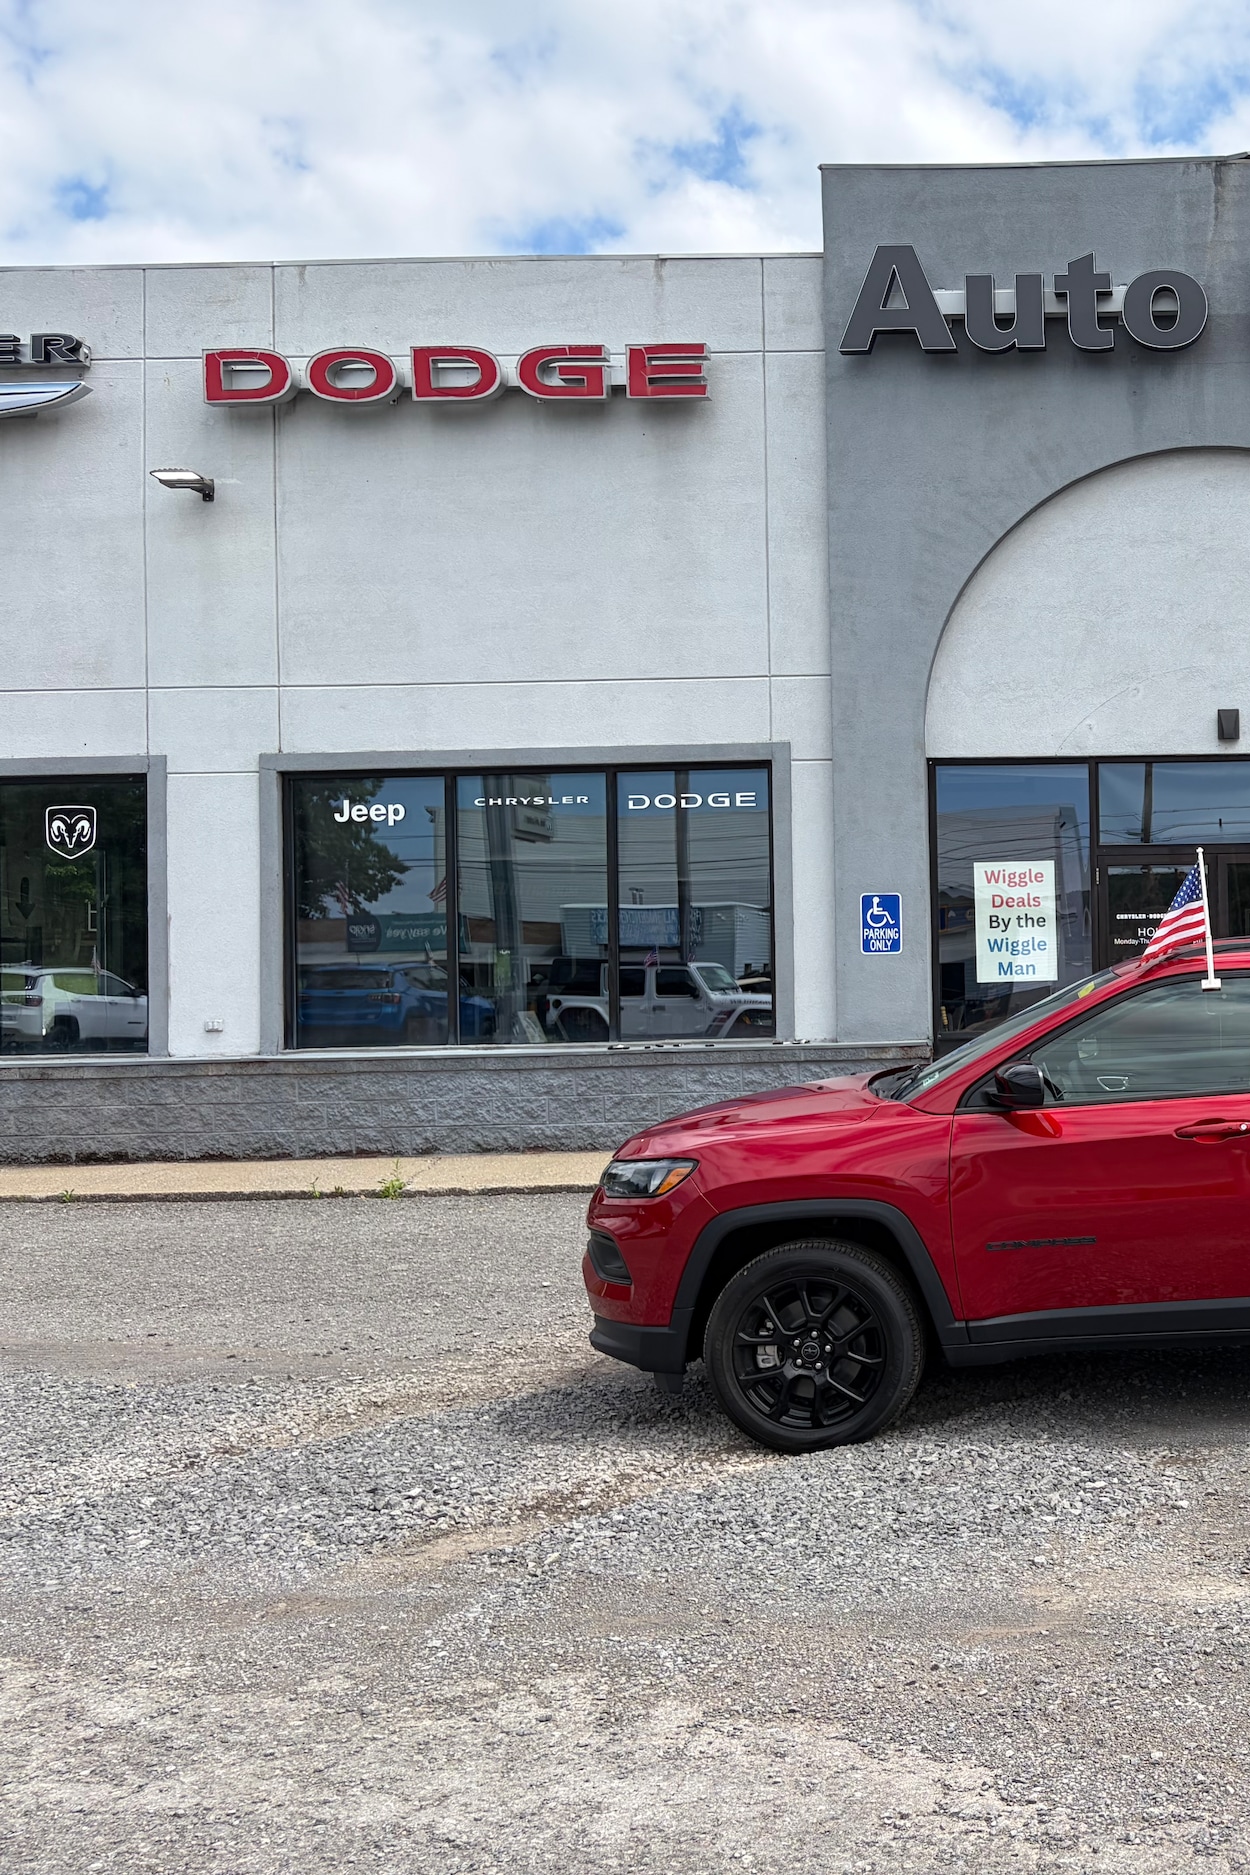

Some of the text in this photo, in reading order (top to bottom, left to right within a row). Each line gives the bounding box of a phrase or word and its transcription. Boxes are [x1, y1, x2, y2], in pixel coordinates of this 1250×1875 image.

[838, 242, 1209, 354] Auto
[202, 343, 711, 407] DODGE
[474, 795, 589, 807] CHRYSLER
[628, 792, 757, 810] DODGE
[333, 799, 406, 826] Jeep
[984, 868, 1044, 888] Wiggle
[991, 893, 1041, 908] Deals
[989, 913, 1046, 933] By the
[1138, 927, 1158, 937] HO
[864, 928, 899, 940] PARKING
[870, 939, 892, 951] ONLY
[987, 937, 1047, 956] Wiggle
[998, 962, 1036, 976] Man
